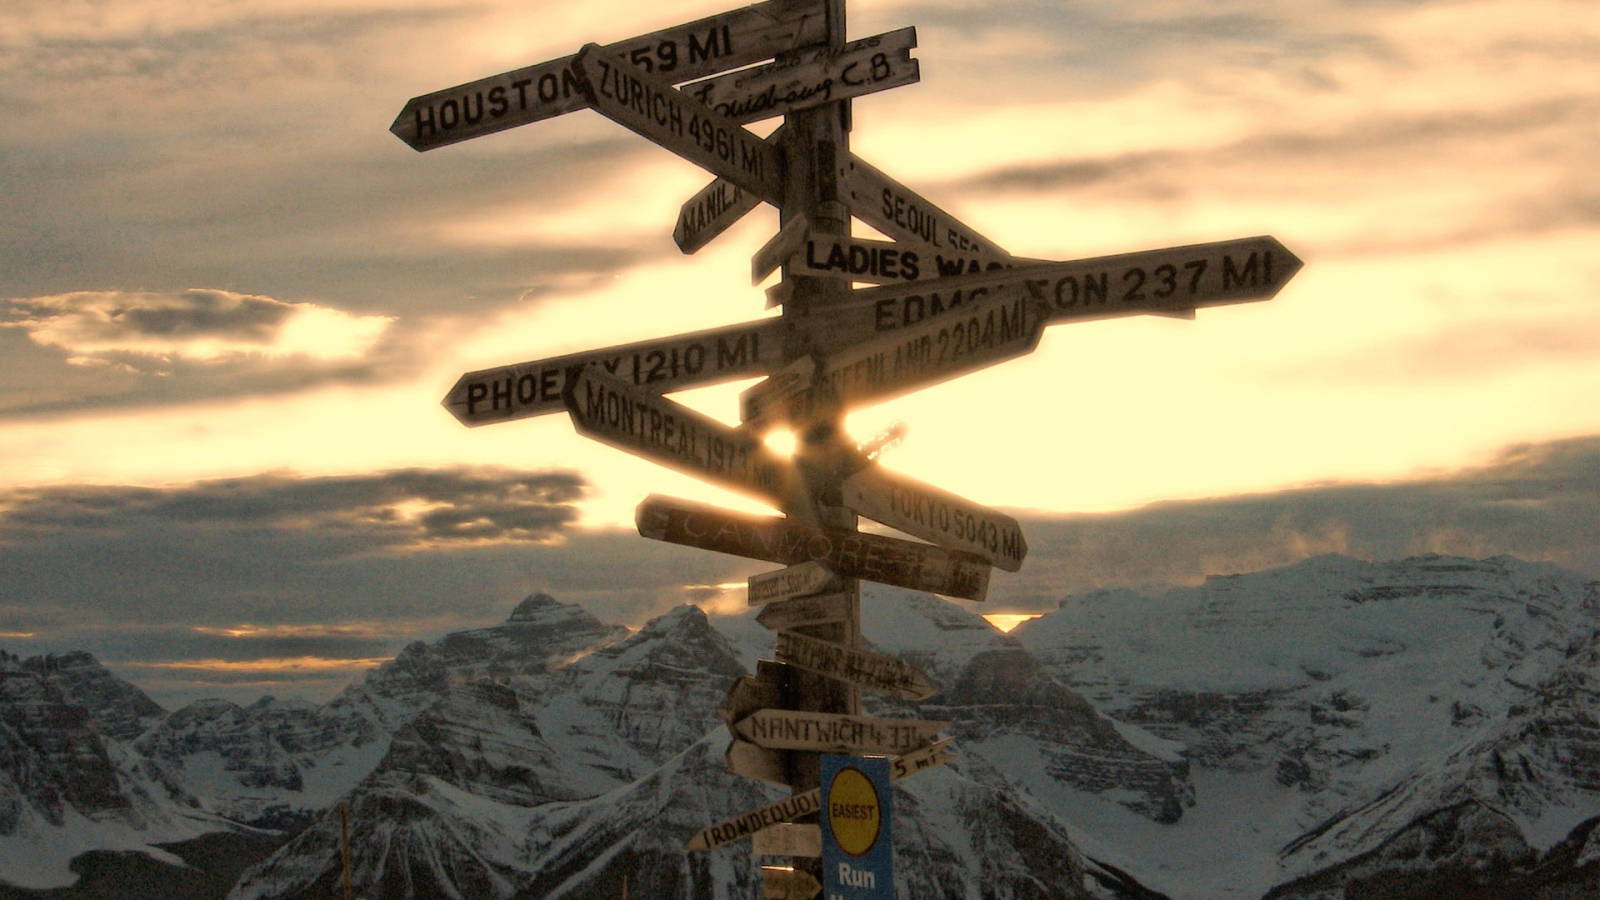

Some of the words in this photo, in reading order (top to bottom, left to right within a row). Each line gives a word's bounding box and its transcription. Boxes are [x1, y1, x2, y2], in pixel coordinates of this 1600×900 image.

[414, 66, 586, 139] HOUSTON
[688, 23, 734, 65] MI
[597, 58, 683, 138] ZURICH
[688, 111, 736, 166] 4961
[741, 144, 764, 182] MI
[881, 187, 942, 248] SEOUL
[806, 239, 920, 281] LADIES
[1121, 257, 1209, 302] 237
[1221, 249, 1278, 292] MI
[632, 342, 706, 387] 1210
[716, 331, 761, 371] MI
[936, 307, 995, 369] 2204
[1000, 295, 1027, 347] MI
[585, 377, 702, 461] MONTREAL
[889, 487, 950, 533] TOKYO
[953, 508, 999, 555] 5043
[1001, 526, 1021, 563] MI
[750, 714, 865, 746] NANTWICH
[831, 802, 875, 822] EASIEST
[838, 861, 876, 890] Run
